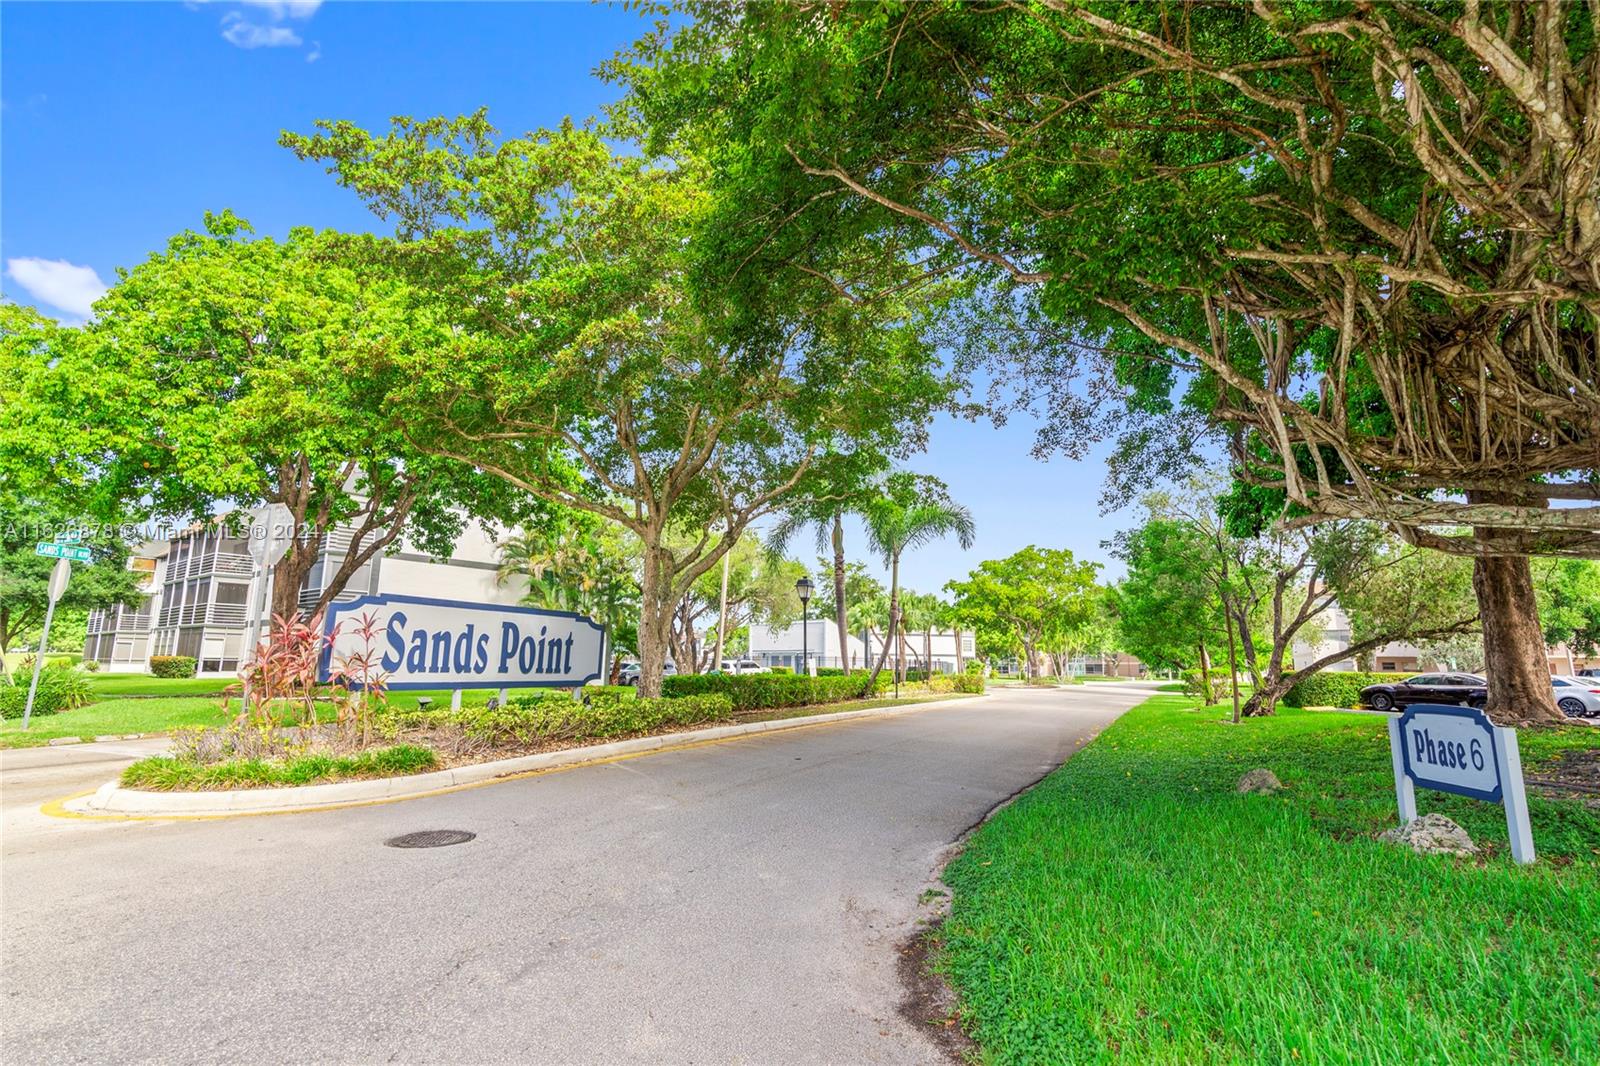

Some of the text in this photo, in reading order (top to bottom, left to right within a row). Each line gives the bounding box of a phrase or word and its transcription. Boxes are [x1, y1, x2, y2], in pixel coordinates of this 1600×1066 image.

[380, 611, 574, 675] Sands Point
[1413, 728, 1484, 772] Phase 6
